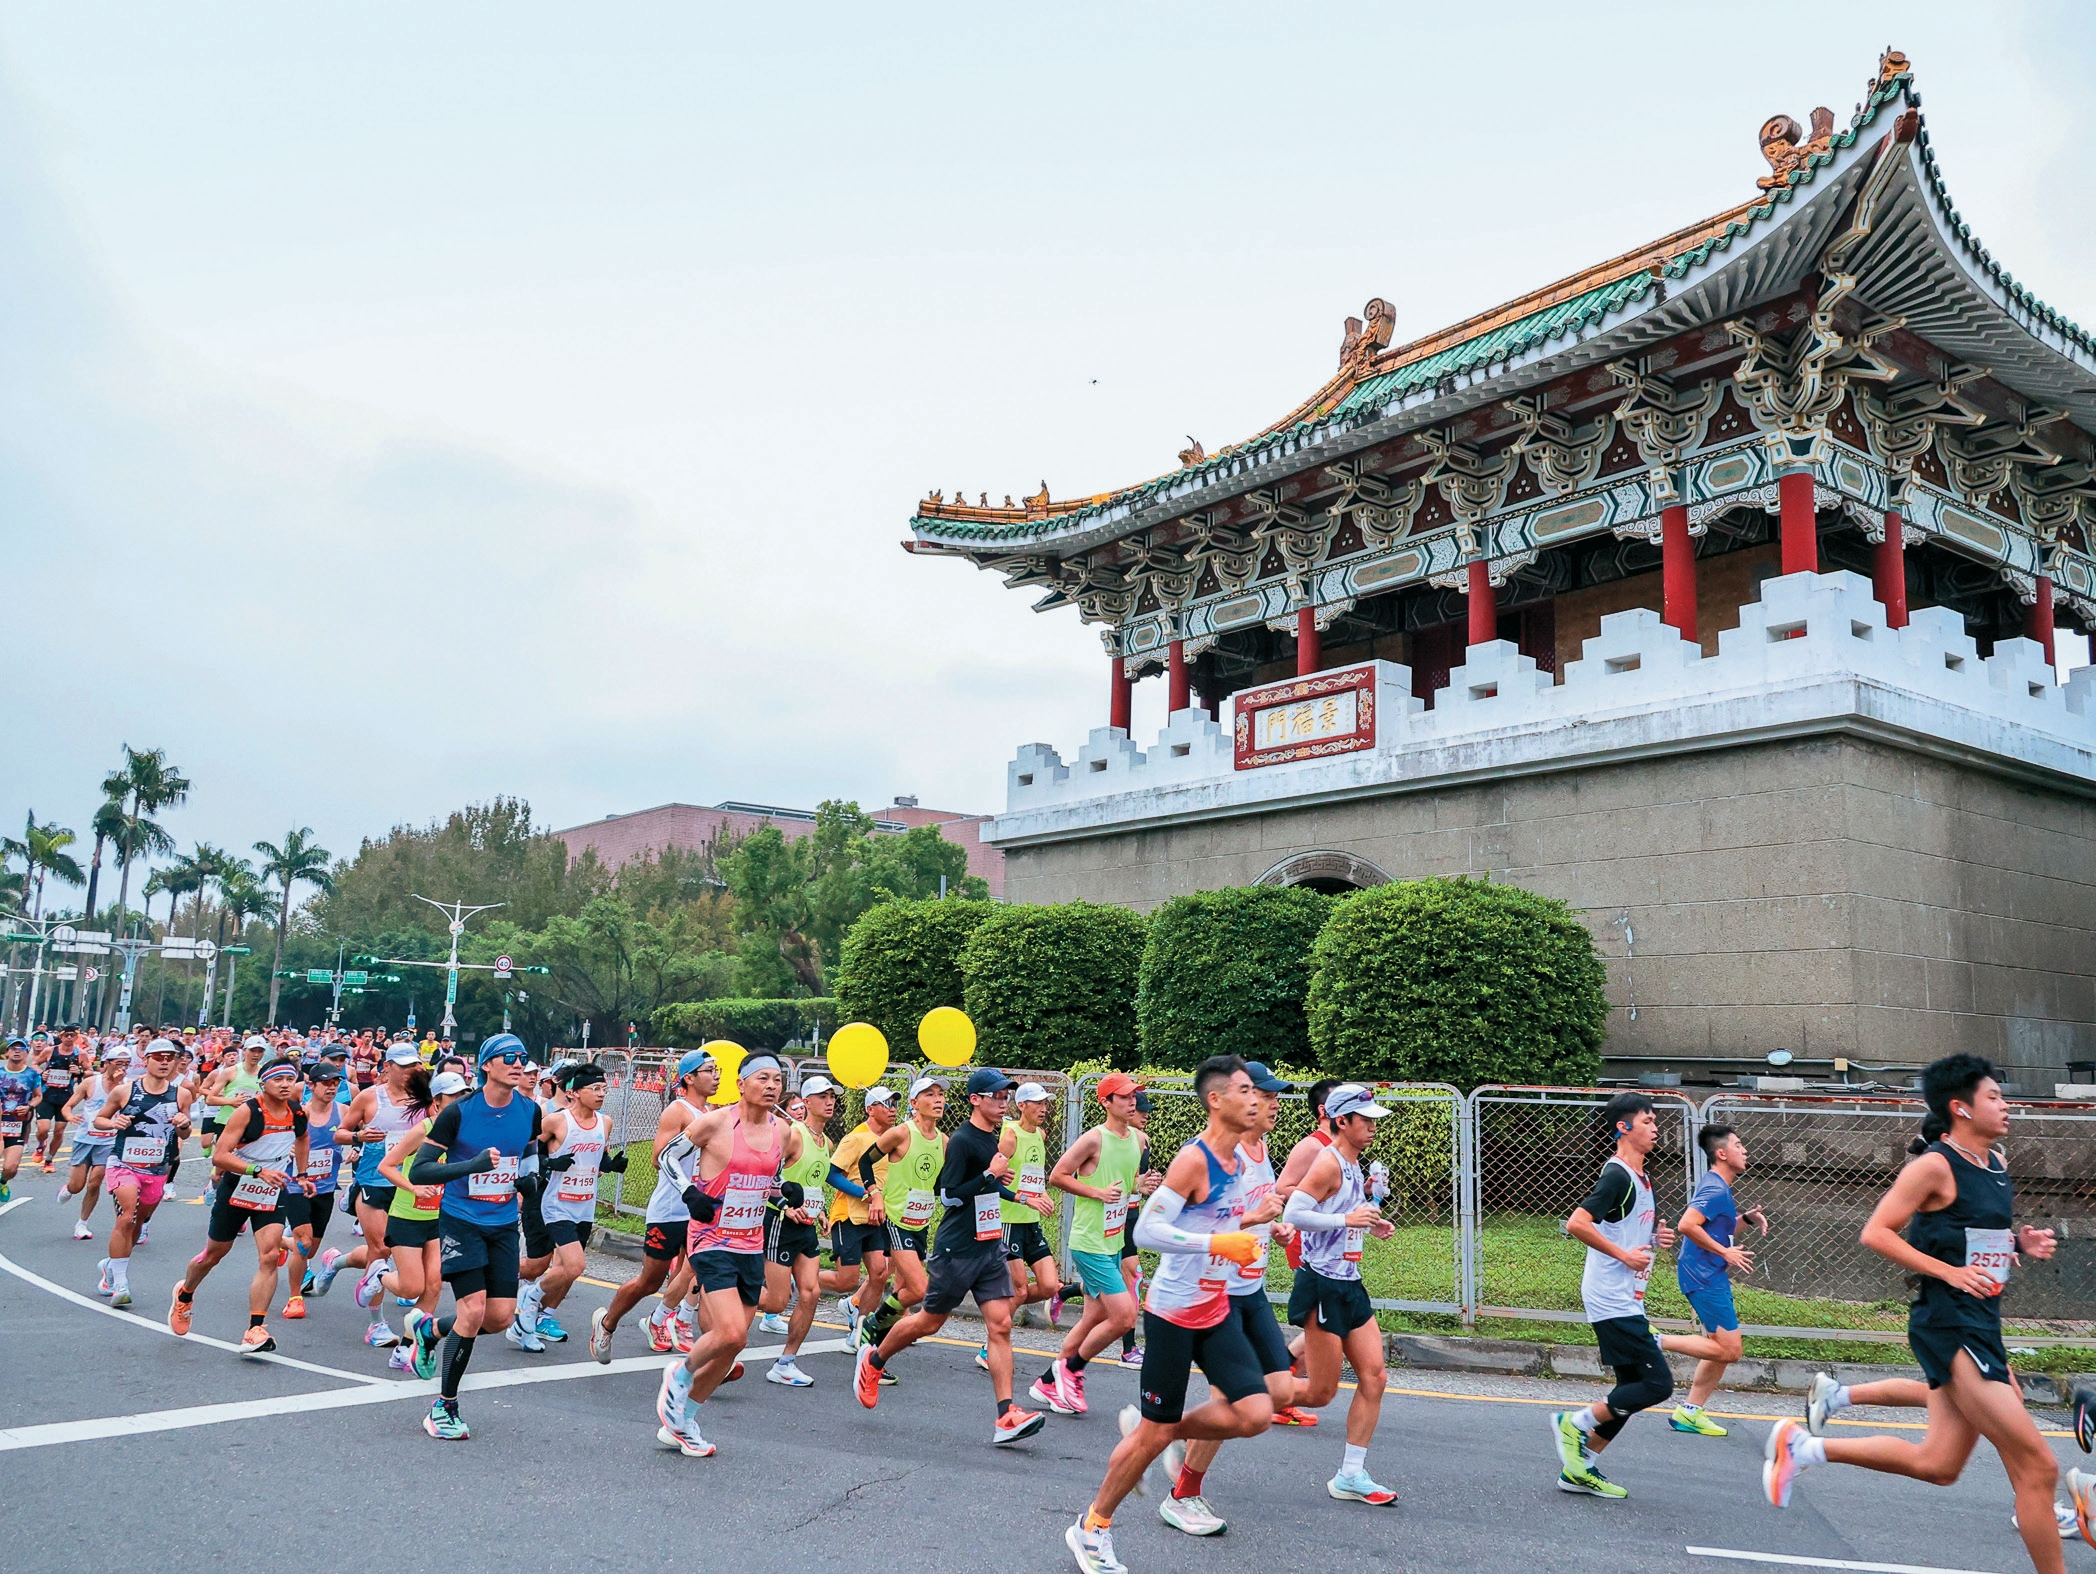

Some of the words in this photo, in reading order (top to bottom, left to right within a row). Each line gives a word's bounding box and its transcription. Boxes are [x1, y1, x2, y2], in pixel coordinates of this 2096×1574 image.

[127, 1148, 163, 1156] 18623
[471, 1172, 517, 1185] 17324
[562, 1176, 594, 1187] 21159
[240, 1183, 278, 1196] 18046
[723, 1205, 765, 1218] 24119
[1971, 1252, 2010, 1267] 2527
